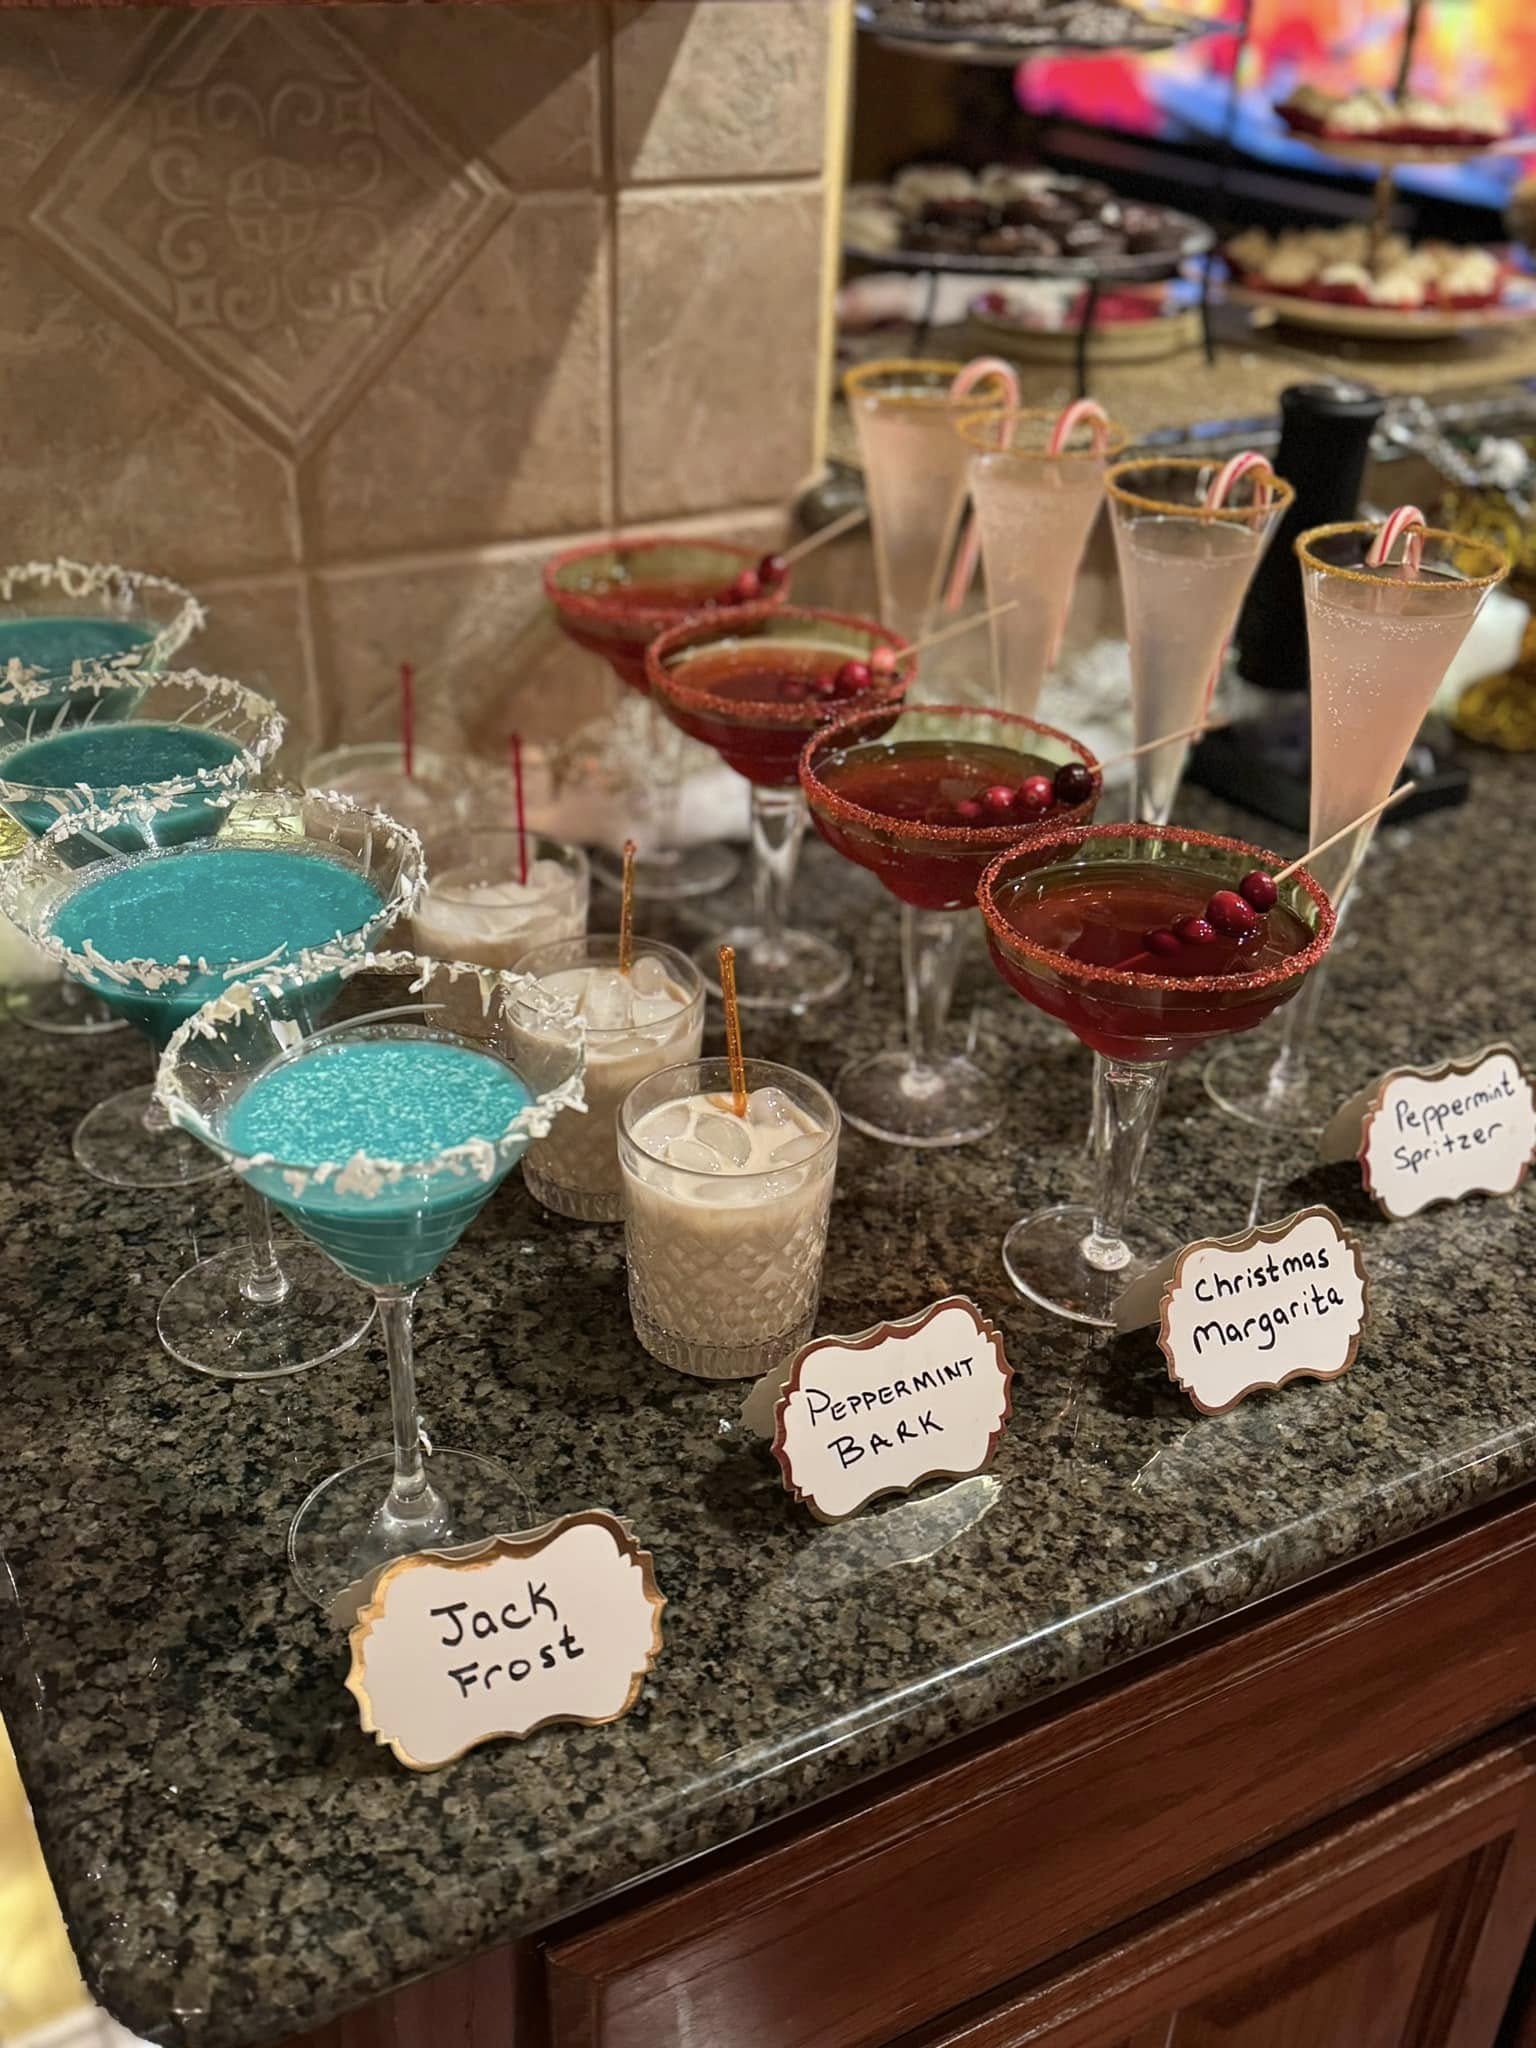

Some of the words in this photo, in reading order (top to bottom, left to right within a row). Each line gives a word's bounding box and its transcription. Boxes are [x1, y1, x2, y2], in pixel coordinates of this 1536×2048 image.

[1395, 1070, 1515, 1136] Peppermint
[1393, 1123, 1503, 1174] Spritzer
[1194, 1248, 1330, 1302] Christmas
[1192, 1284, 1344, 1354] Margarita
[805, 1357, 974, 1427] PEPPERMINT
[827, 1410, 944, 1469] BARK
[430, 1580, 558, 1647] Jack
[447, 1624, 585, 1698] Frost
